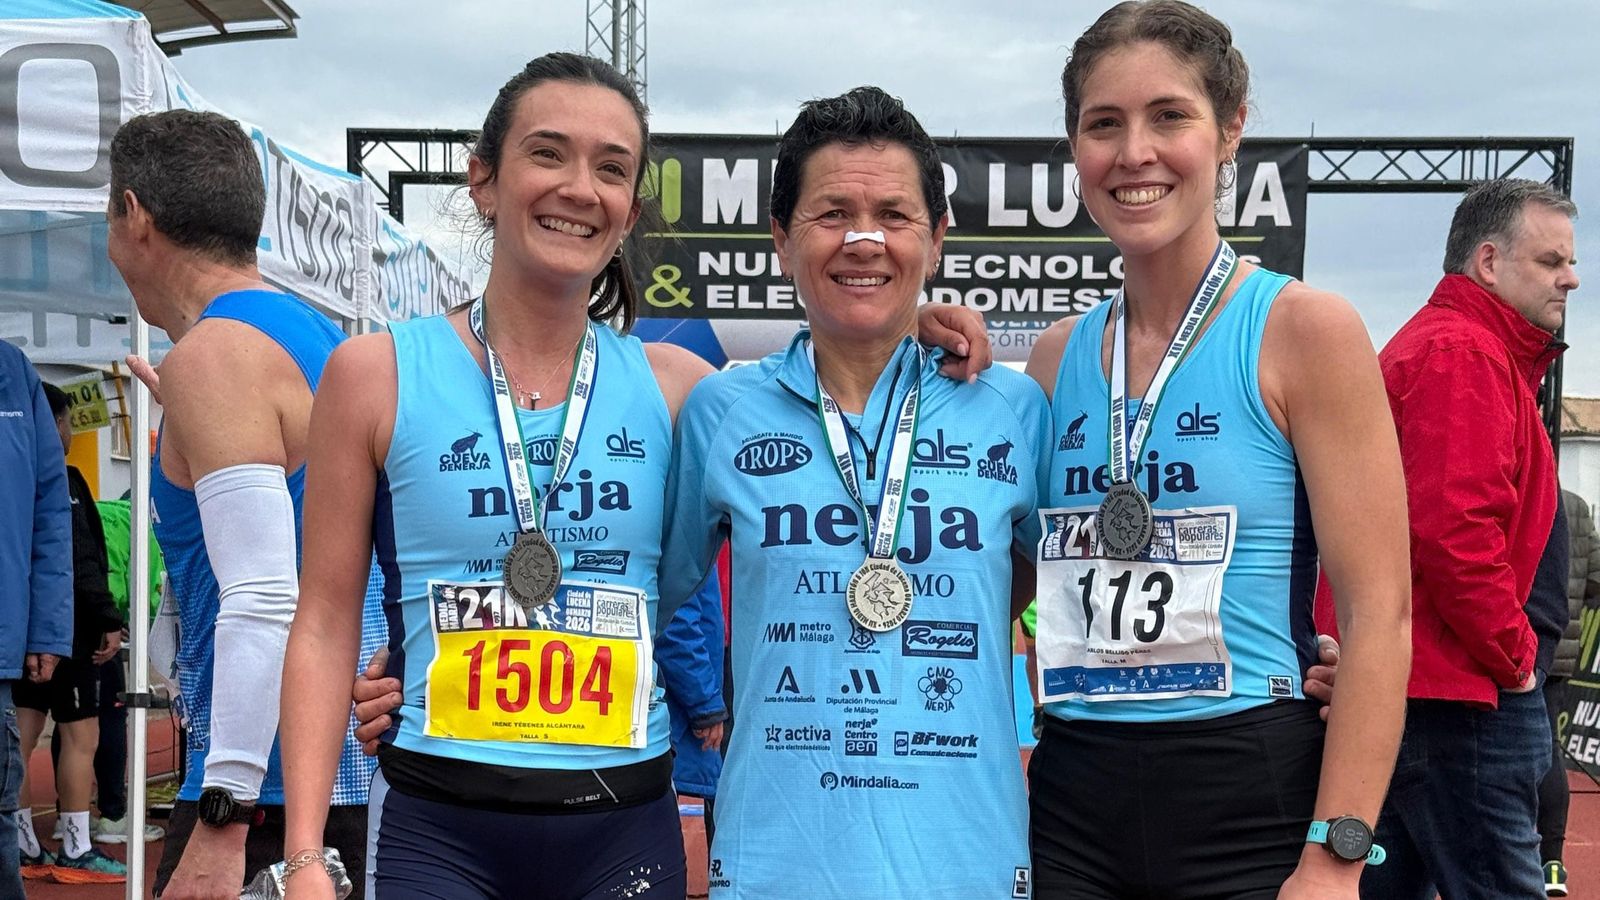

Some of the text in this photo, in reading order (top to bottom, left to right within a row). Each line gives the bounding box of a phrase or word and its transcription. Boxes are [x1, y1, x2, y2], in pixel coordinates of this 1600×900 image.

[987, 162, 1292, 228] LUNA
[1167, 340, 1185, 359] XII
[1179, 314, 1199, 343] MEDIA
[1193, 275, 1222, 317] MARATÓN
[1113, 413, 1122, 439] MEDIA
[439, 453, 491, 464] CUEVA
[738, 441, 808, 469] TROPS
[440, 462, 491, 472] DENERJA
[977, 459, 1018, 479] CUEVA
[977, 469, 1018, 486] DENERJA
[1064, 450, 1200, 503] neja
[468, 469, 632, 521] nrja
[892, 479, 902, 496] 2026
[760, 488, 983, 564] neja
[1178, 525, 1217, 534] carreras
[494, 526, 609, 547] ATTISMO
[1179, 532, 1223, 543] populares
[881, 533, 892, 557] LUCENA
[1149, 543, 1175, 559] 2026
[794, 569, 955, 598] ATLMO
[1078, 568, 1173, 643] 113
[566, 616, 590, 632] 2026
[800, 622, 832, 631] metro
[937, 622, 973, 630] COMERCIAL
[800, 631, 834, 643] Málaga
[908, 626, 975, 649] Rogelio
[462, 639, 613, 716] 1504
[927, 666, 954, 679] CMD
[864, 697, 897, 705] Provincial
[924, 700, 955, 713] NERJA
[854, 706, 879, 715] Málaga
[845, 719, 871, 730] nerja
[785, 725, 831, 741] activa
[845, 730, 877, 739] Centro
[911, 731, 979, 748] BFwork
[846, 741, 875, 752] aen
[911, 749, 978, 759] Comunicaciones
[841, 776, 919, 790] Mindalia.com
